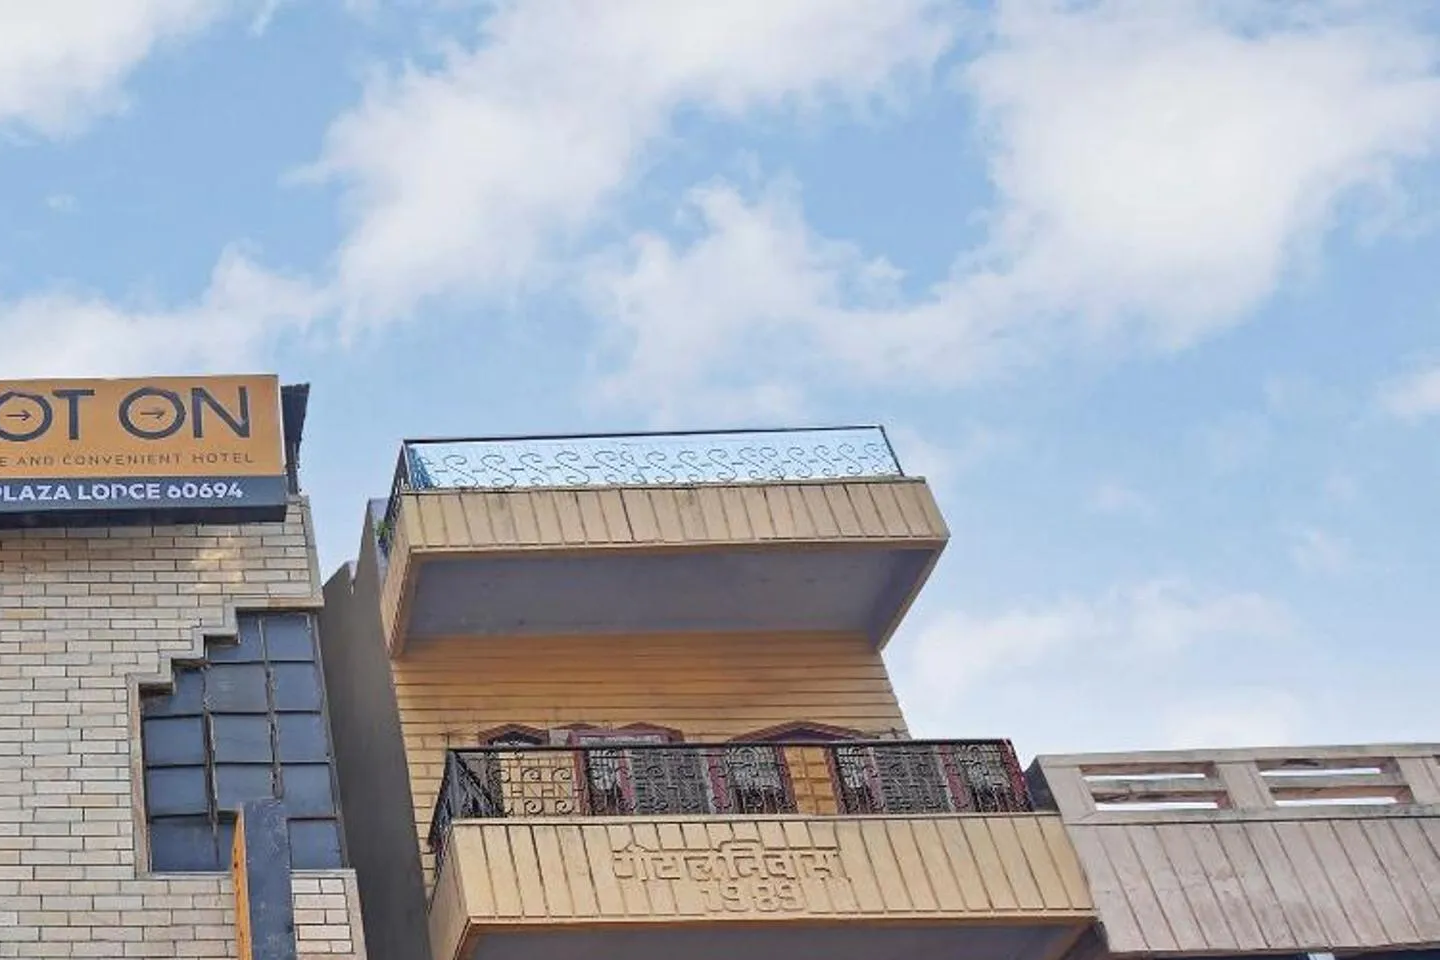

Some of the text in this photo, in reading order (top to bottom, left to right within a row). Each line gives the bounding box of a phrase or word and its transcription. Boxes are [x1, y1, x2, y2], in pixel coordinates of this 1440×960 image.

[118, 386, 251, 440] ON
[16, 456, 54, 467] AND
[62, 453, 181, 466] CONVENIENT
[192, 452, 254, 464] HOTEL
[166, 481, 244, 499] 60694
